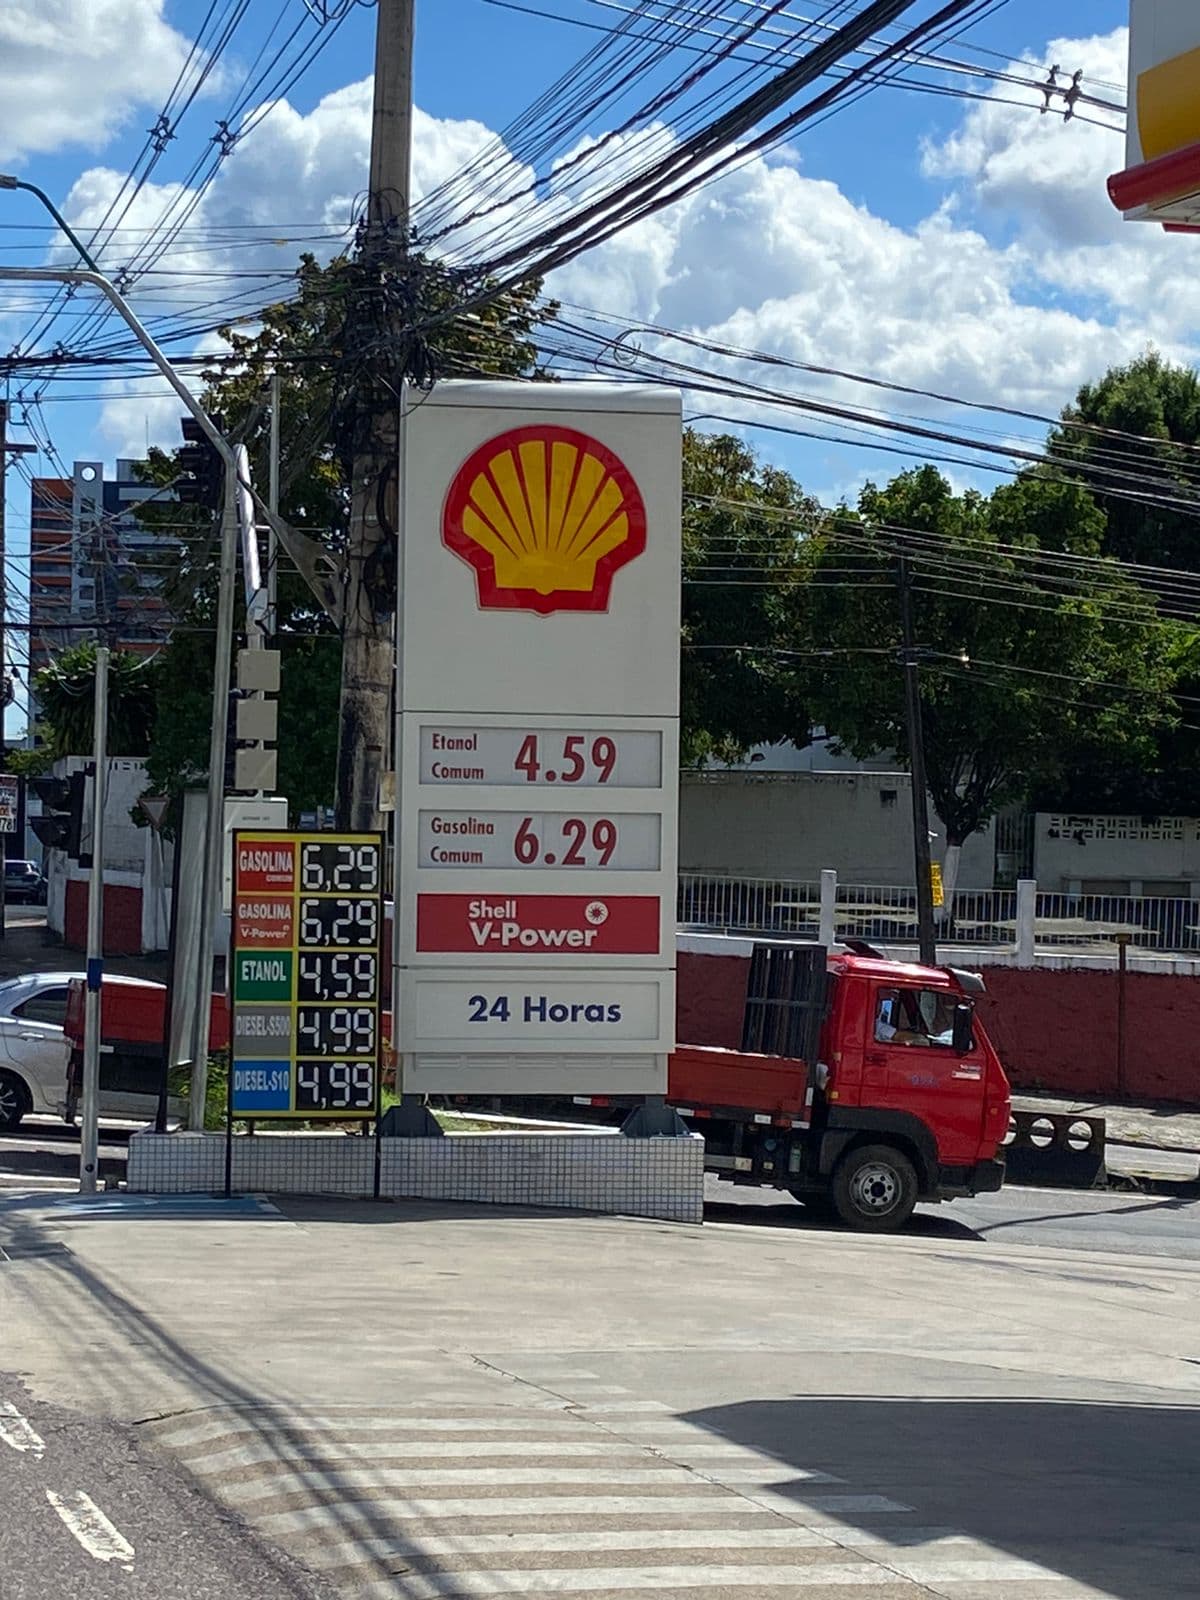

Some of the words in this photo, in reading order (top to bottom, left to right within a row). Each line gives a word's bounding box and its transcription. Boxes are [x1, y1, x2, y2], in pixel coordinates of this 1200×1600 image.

[432, 733, 477, 751] Etanol
[514, 735, 617, 783] 4.59
[431, 762, 484, 780] Comum
[431, 817, 494, 835] Gasolina
[514, 817, 617, 866] 6.29
[239, 851, 293, 872] GASOLINA
[430, 846, 483, 863] Comum
[303, 845, 378, 892] 6,29
[238, 904, 292, 919] GASOLINA
[468, 900, 517, 919] Shell
[240, 927, 287, 938] V-Power
[302, 899, 376, 946] 6,29
[469, 922, 598, 947] V-Power
[241, 960, 287, 981] ETANOL
[300, 954, 376, 1000] 4,59
[468, 995, 511, 1022] 24
[523, 996, 622, 1023] Horas
[299, 1008, 374, 1055] 4,99
[234, 1070, 290, 1091] DIESEL-S10
[298, 1062, 373, 1109] 4,99
